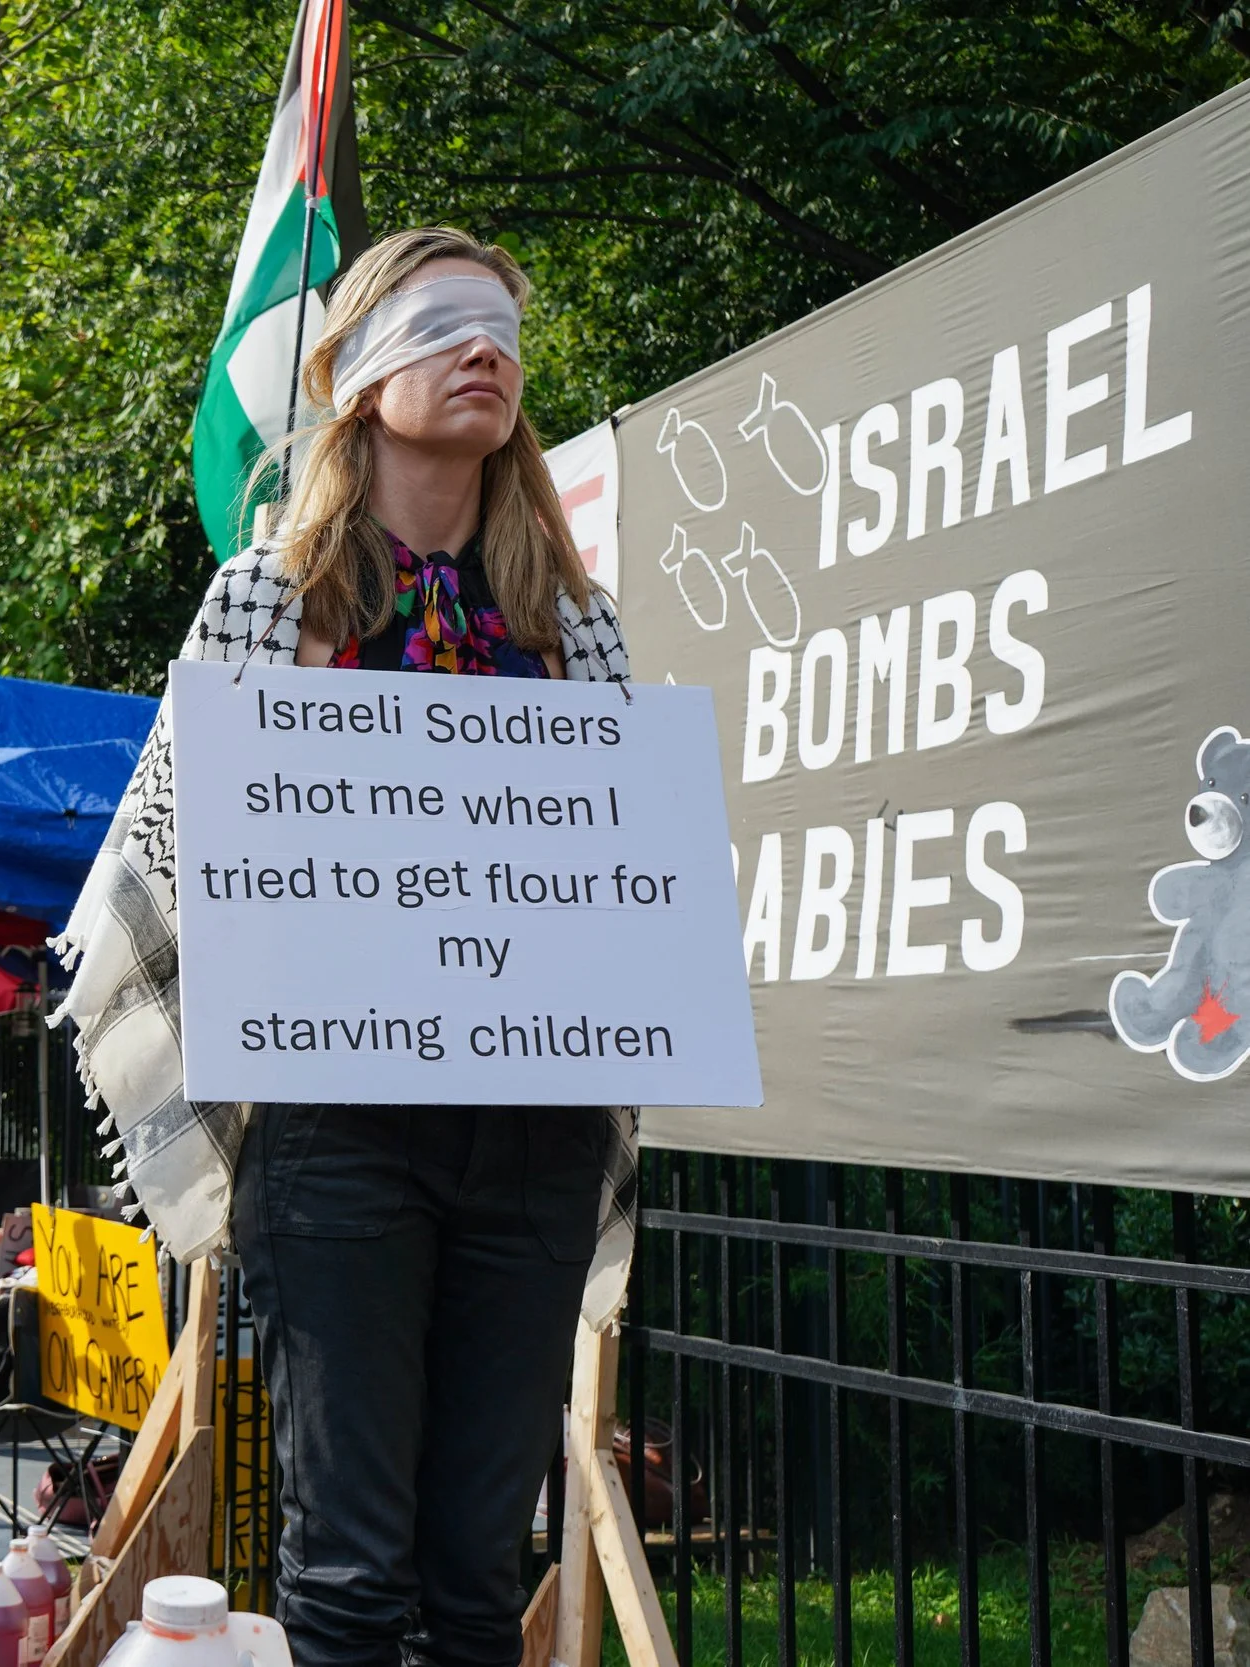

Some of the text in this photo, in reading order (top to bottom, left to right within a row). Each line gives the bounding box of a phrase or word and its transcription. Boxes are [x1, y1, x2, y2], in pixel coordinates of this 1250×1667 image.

[819, 284, 1193, 569] ISRAEL
[742, 569, 1049, 784] BOMBS
[257, 689, 621, 746] Israeli Soldiers
[246, 773, 619, 826] shot me when I
[201, 858, 677, 909] tried to get flour for
[732, 801, 1027, 982] ABIES
[438, 936, 511, 978] my
[241, 1008, 673, 1060] starving children
[38, 1215, 82, 1298] YOU
[96, 1245, 145, 1322] ARE
[47, 1331, 161, 1422] ON CAMERA
